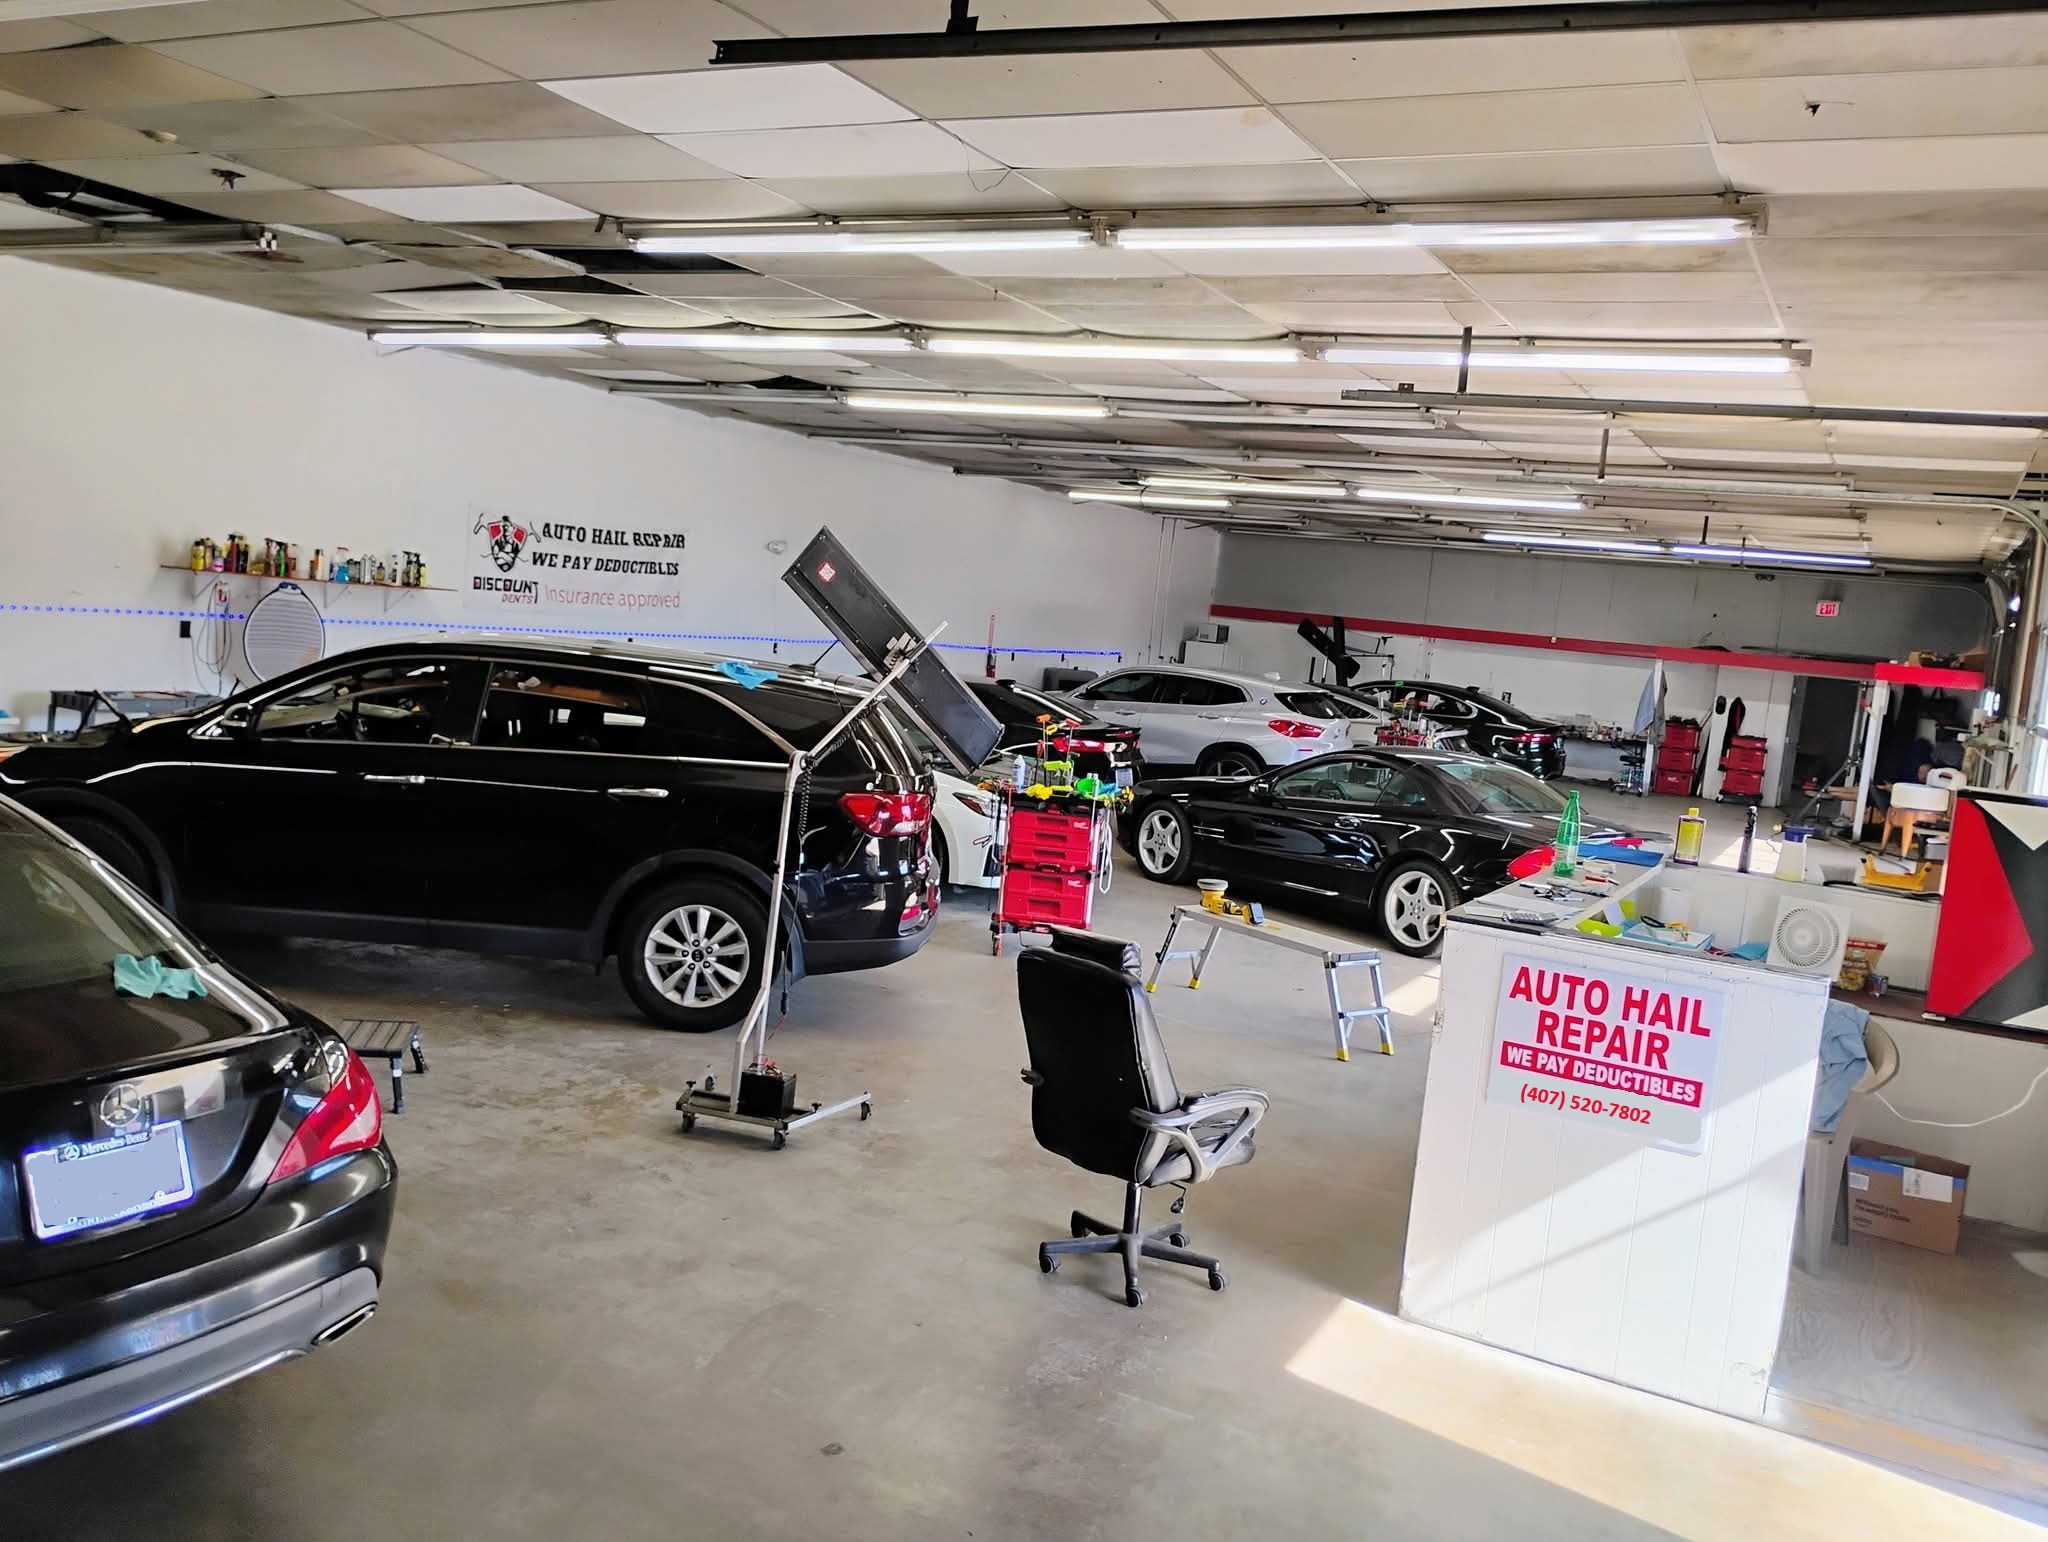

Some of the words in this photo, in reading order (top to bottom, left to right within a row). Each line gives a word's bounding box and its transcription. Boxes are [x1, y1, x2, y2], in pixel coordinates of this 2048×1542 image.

[542, 522, 587, 543] AUTO
[591, 528, 629, 546] HAIL
[632, 532, 686, 549] REPAIR
[532, 551, 559, 568] WE
[562, 554, 592, 571] PAY
[594, 558, 680, 576] DEDUCTIBLES
[473, 576, 539, 603] DISCOUNT
[617, 592, 681, 613] approved
[1509, 966, 1610, 1015] AUTO
[1621, 985, 1712, 1038] HAIL
[1535, 1009, 1670, 1071] REPAIR
[1506, 1045, 1532, 1068] WE
[1536, 1052, 1570, 1075] PAY
[1572, 1059, 1696, 1102] DEDUCTIBLES
[1520, 1083, 1566, 1111] (407)
[1569, 1094, 1652, 1125] 520-7802
